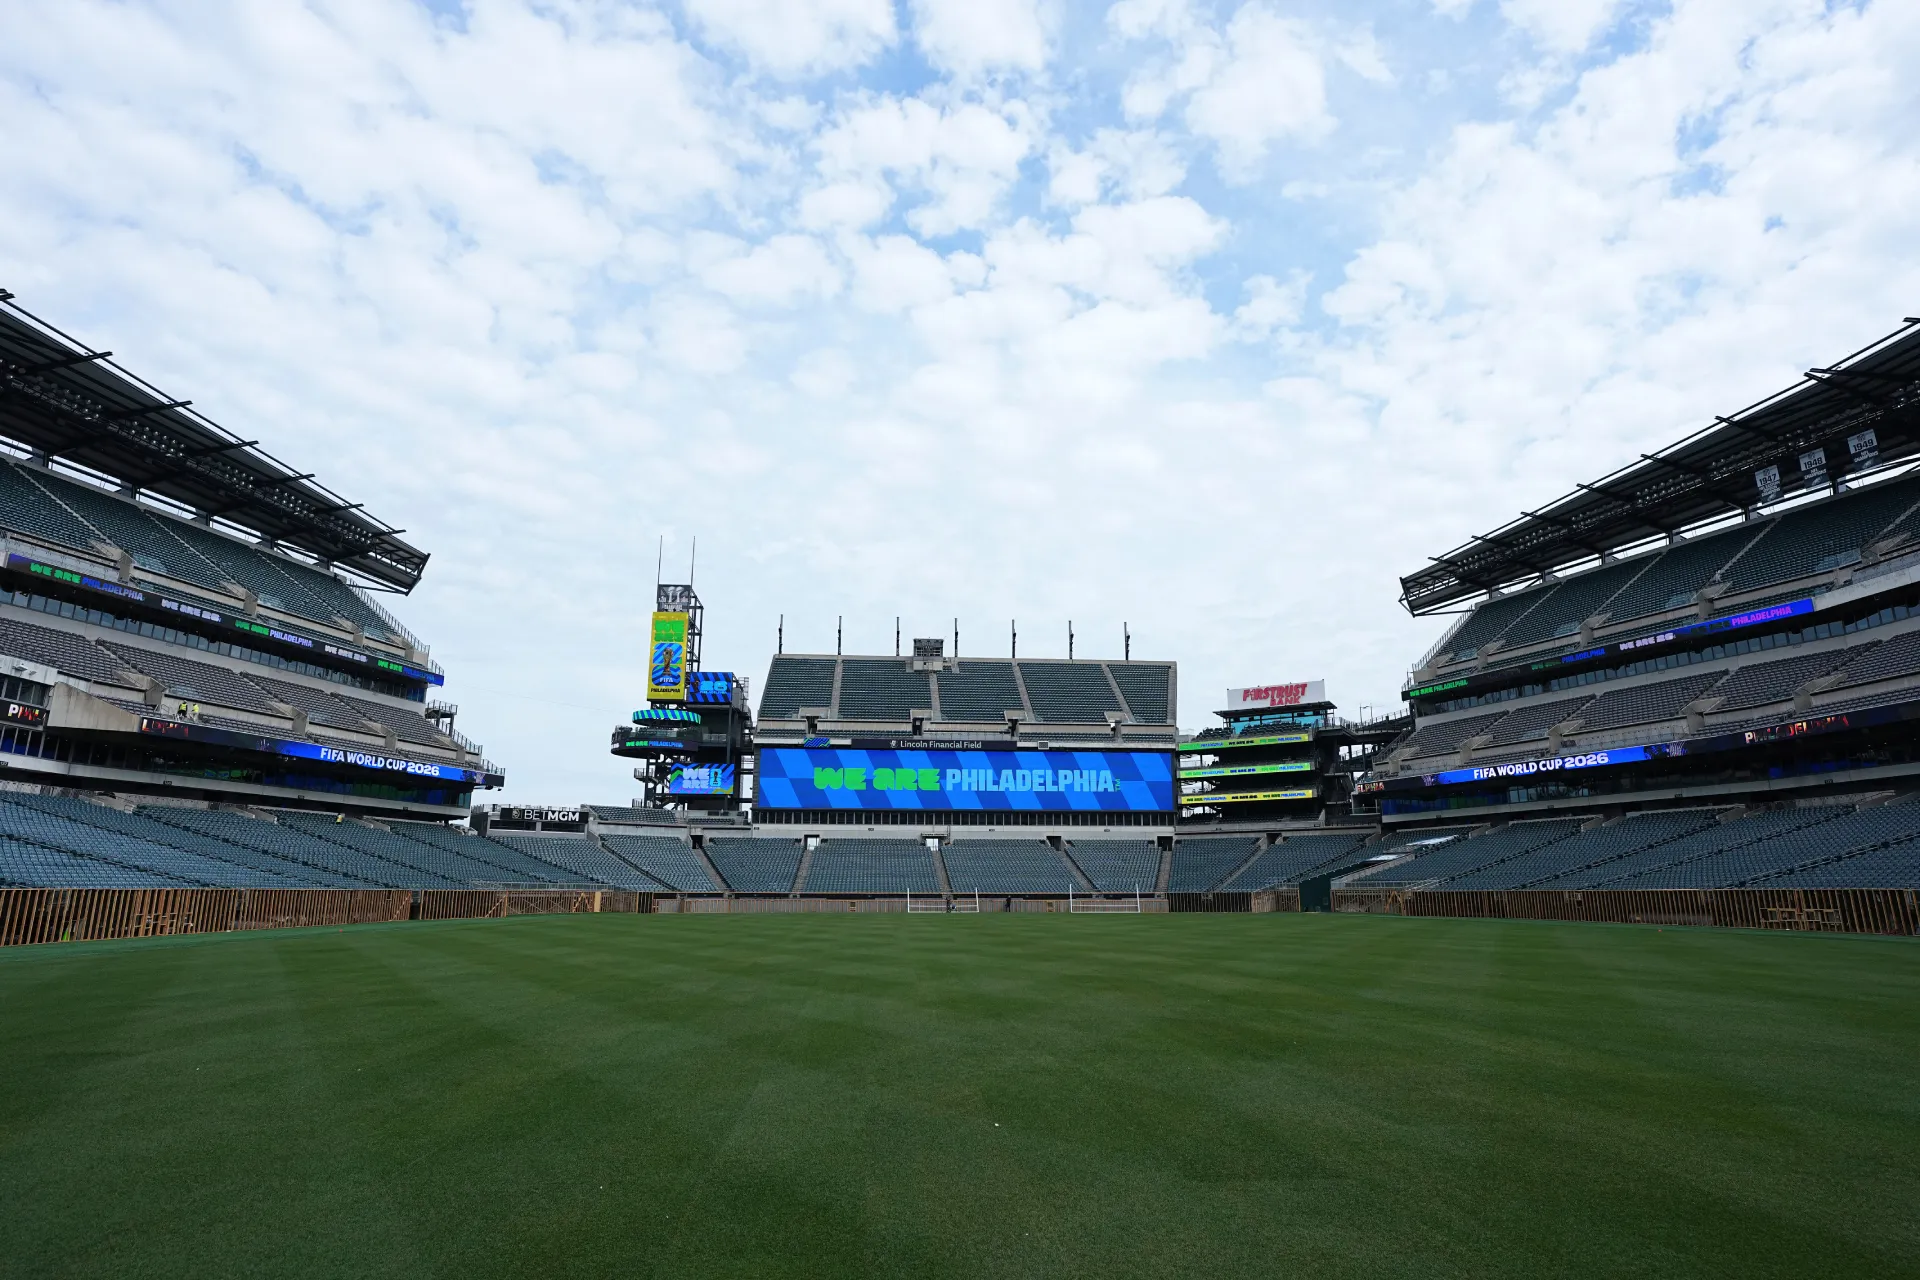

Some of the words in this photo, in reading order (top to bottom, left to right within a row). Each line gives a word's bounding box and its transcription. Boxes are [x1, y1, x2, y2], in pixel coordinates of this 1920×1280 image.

[1853, 439, 1874, 451] 1949
[1804, 457, 1822, 470] 1948
[1760, 474, 1776, 486] 1947
[82, 576, 143, 601] PHILADELPHIA
[1732, 606, 1792, 626] PHILADELPHIA
[270, 629, 313, 648] PHILADELPHIA
[1434, 680, 1468, 692] PHILADELPHIA
[1270, 696, 1301, 706] BANK
[964, 741, 982, 749] Field
[320, 748, 345, 762] FIFA
[346, 752, 384, 768] WORLD
[386, 758, 406, 771] CUP
[407, 762, 439, 776] 2026
[1474, 768, 1496, 779] FIFA
[1497, 762, 1537, 776] WORLD
[1539, 758, 1562, 771] CUP
[1564, 752, 1608, 768] 2026
[814, 767, 866, 790] WE
[872, 767, 940, 791] ARE
[946, 769, 1114, 792] PHILADELPHIA
[525, 810, 580, 822] BETMGM
